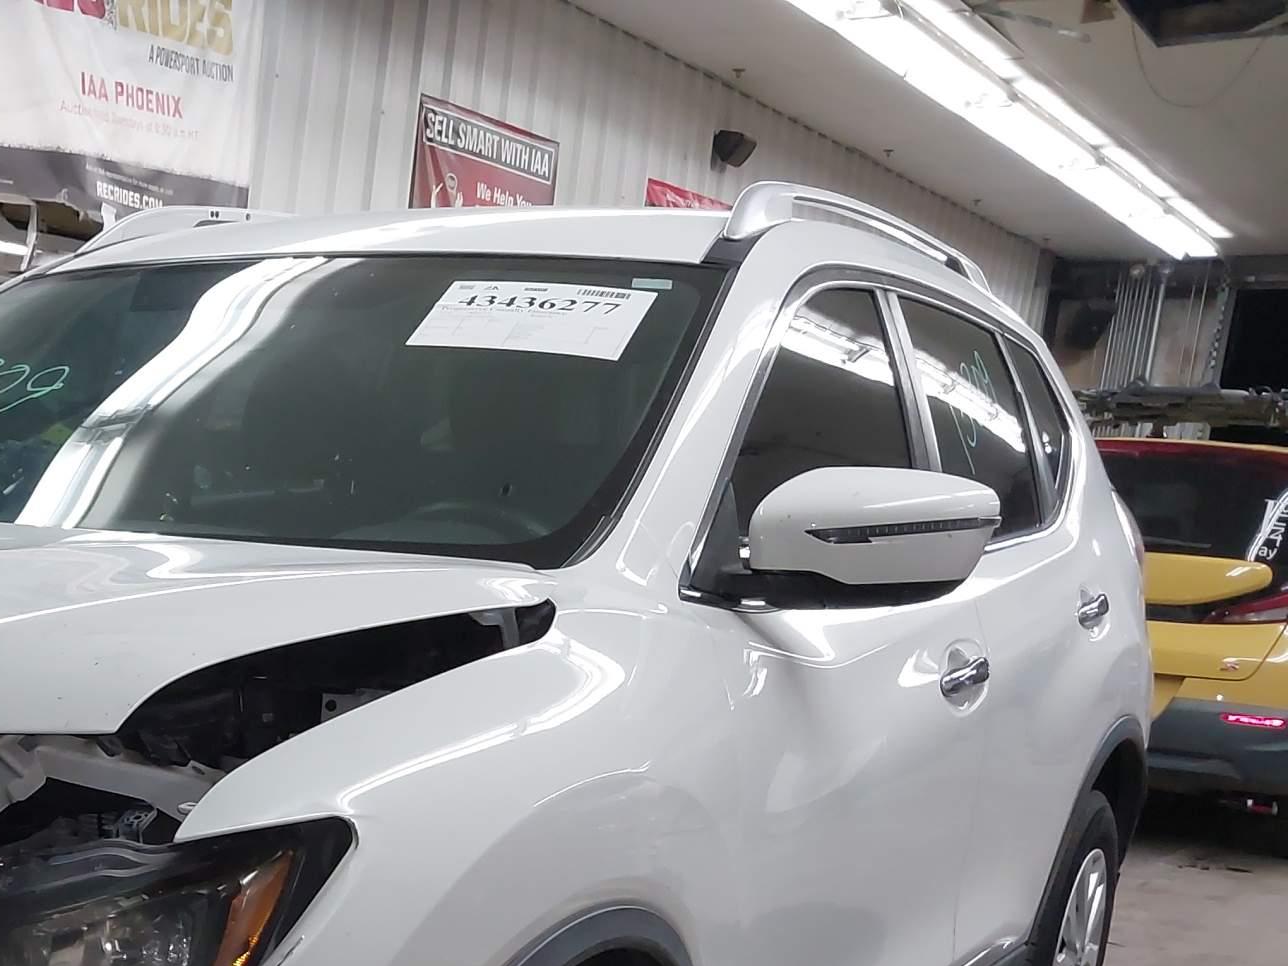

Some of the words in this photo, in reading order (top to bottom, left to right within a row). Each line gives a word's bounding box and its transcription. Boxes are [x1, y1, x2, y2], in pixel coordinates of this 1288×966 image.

[148, 44, 155, 63] A
[155, 46, 200, 76] POWERSPORT
[202, 58, 234, 82] AUCTION
[81, 72, 109, 101] IAA
[114, 81, 183, 119] PHOENIX
[426, 112, 455, 145] SELL
[457, 122, 500, 160] SMART
[500, 138, 530, 171] WITH
[530, 148, 550, 178] IAA
[96, 180, 164, 209] RECRIDES.COM
[476, 181, 492, 201] We
[493, 187, 514, 207] Help
[458, 294, 623, 316] 43436277
